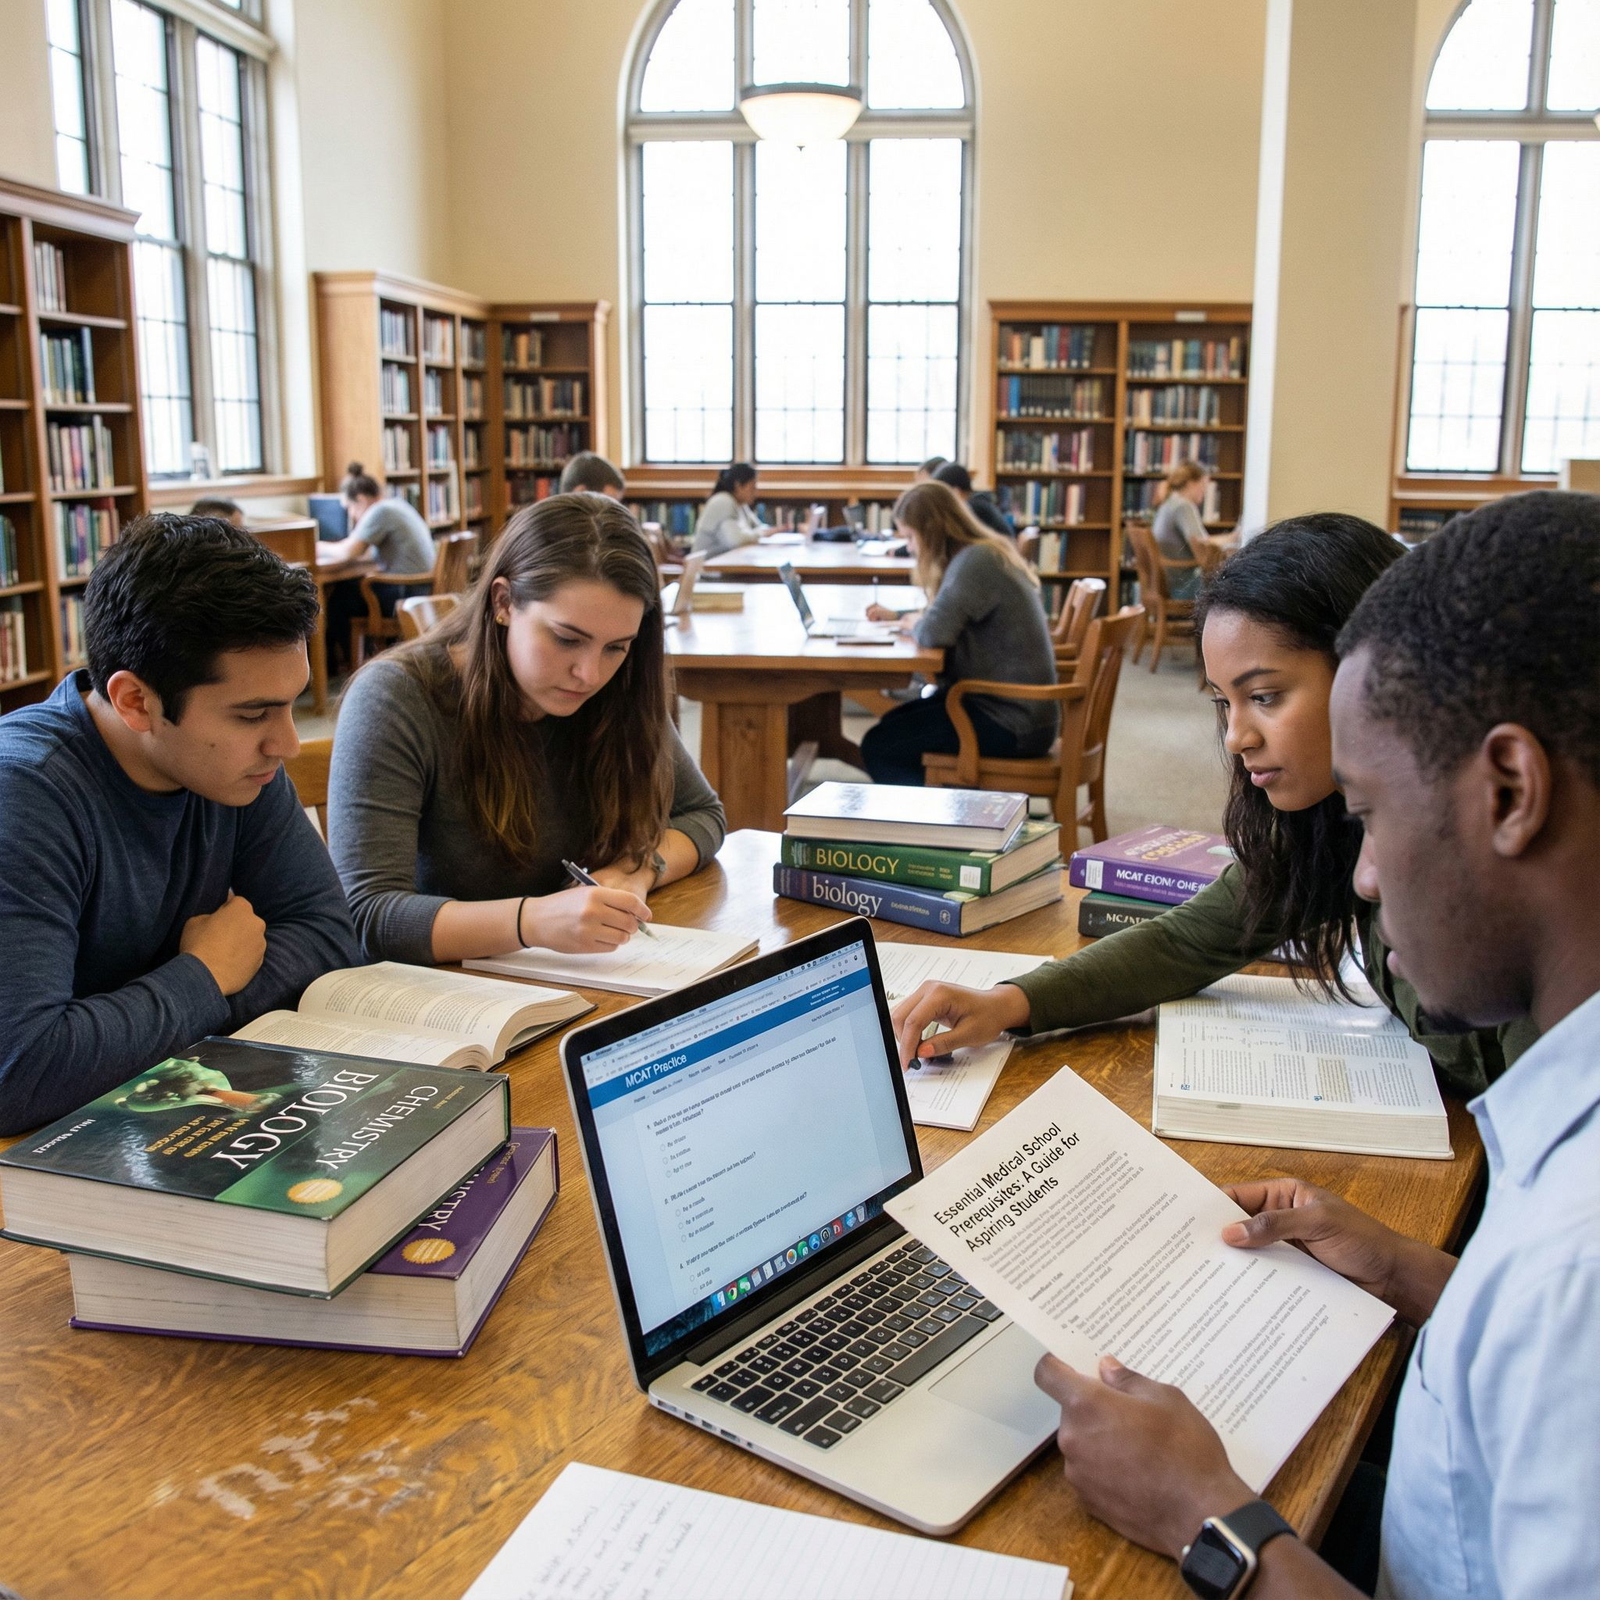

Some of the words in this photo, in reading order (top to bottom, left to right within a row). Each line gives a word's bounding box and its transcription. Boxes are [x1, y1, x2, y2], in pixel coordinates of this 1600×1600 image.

[812, 875, 883, 918] biology
[816, 848, 900, 876] BIOLOGY
[1116, 869, 1143, 882] MCAT
[625, 1066, 652, 1088] MCAT
[652, 1054, 687, 1075] Practice
[210, 1069, 379, 1170] BIOLOGY
[315, 1085, 439, 1170] CHEMISTRY
[934, 1182, 987, 1225] Essential
[981, 1151, 1027, 1189] Medical
[1022, 1122, 1062, 1156] School
[949, 1179, 1025, 1238] Prerequisites:
[1021, 1170, 1035, 1184] A
[1030, 1146, 1065, 1174] Guide
[1060, 1132, 1081, 1150] for
[965, 1214, 1016, 1252] Aspiring
[1009, 1176, 1059, 1217] Students
